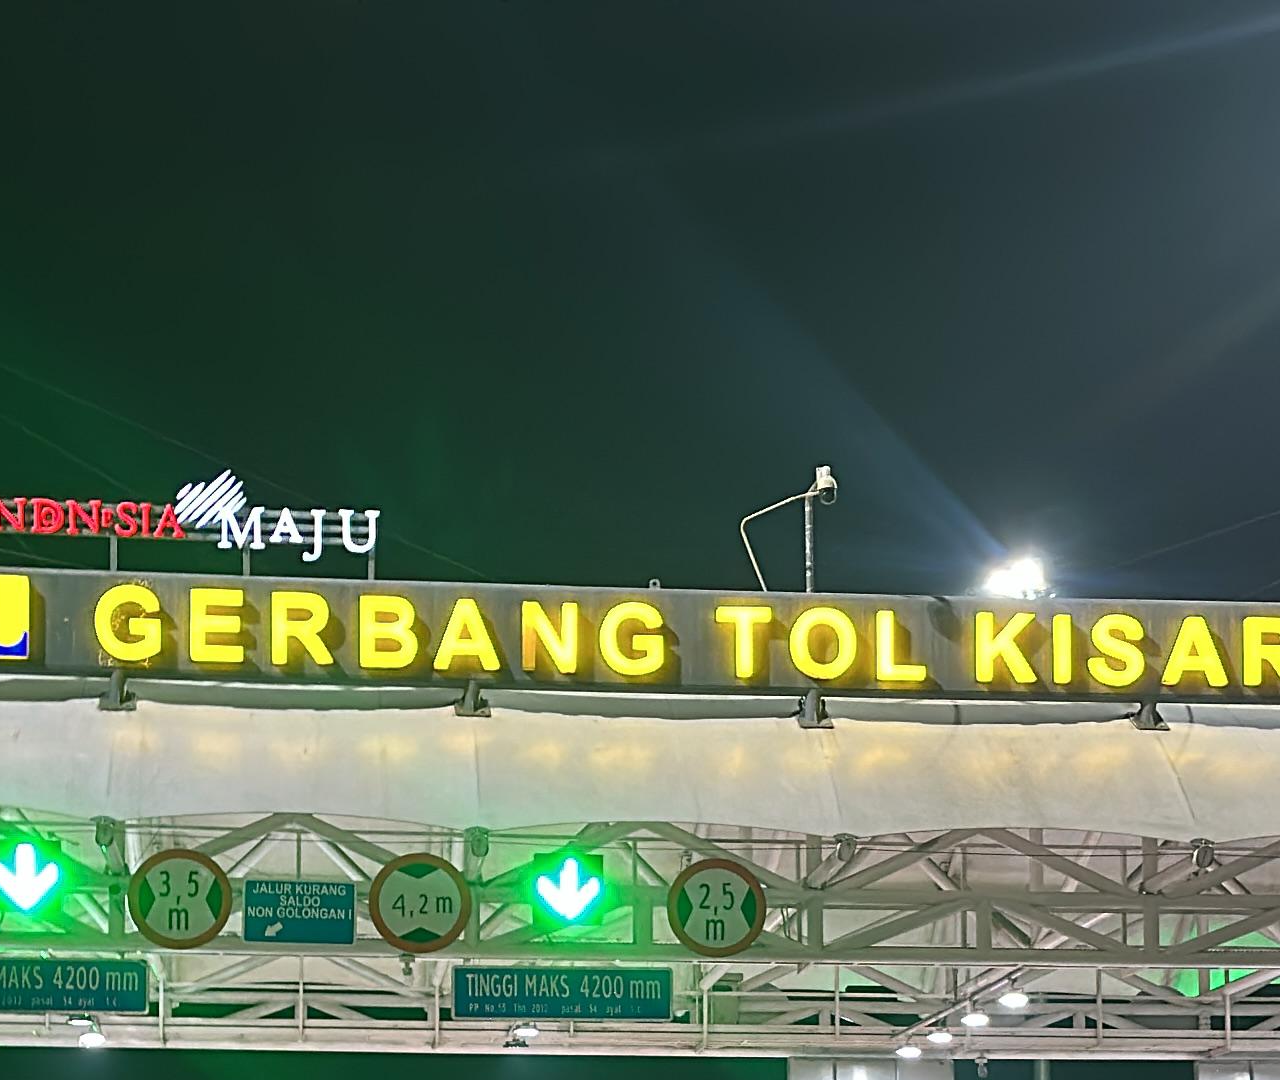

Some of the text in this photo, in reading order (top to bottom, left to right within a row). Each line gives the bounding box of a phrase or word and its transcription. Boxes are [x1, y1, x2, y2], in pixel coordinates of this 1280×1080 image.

[217, 506, 381, 562] MAJU
[93, 583, 666, 677] GERBANG
[713, 605, 926, 682] TOL
[159, 870, 199, 905] 3,5
[252, 882, 347, 896] JALUR KURANG
[699, 883, 734, 915] 2,5
[247, 906, 273, 918] NON
[276, 907, 345, 919] GOLONGAN
[279, 894, 321, 907] SALDO
[168, 908, 189, 930] m
[705, 918, 725, 940] m
[53, 965, 100, 991] 4200
[105, 970, 139, 992] mm
[466, 974, 661, 999] TINGGI MAKS 4200 mm
